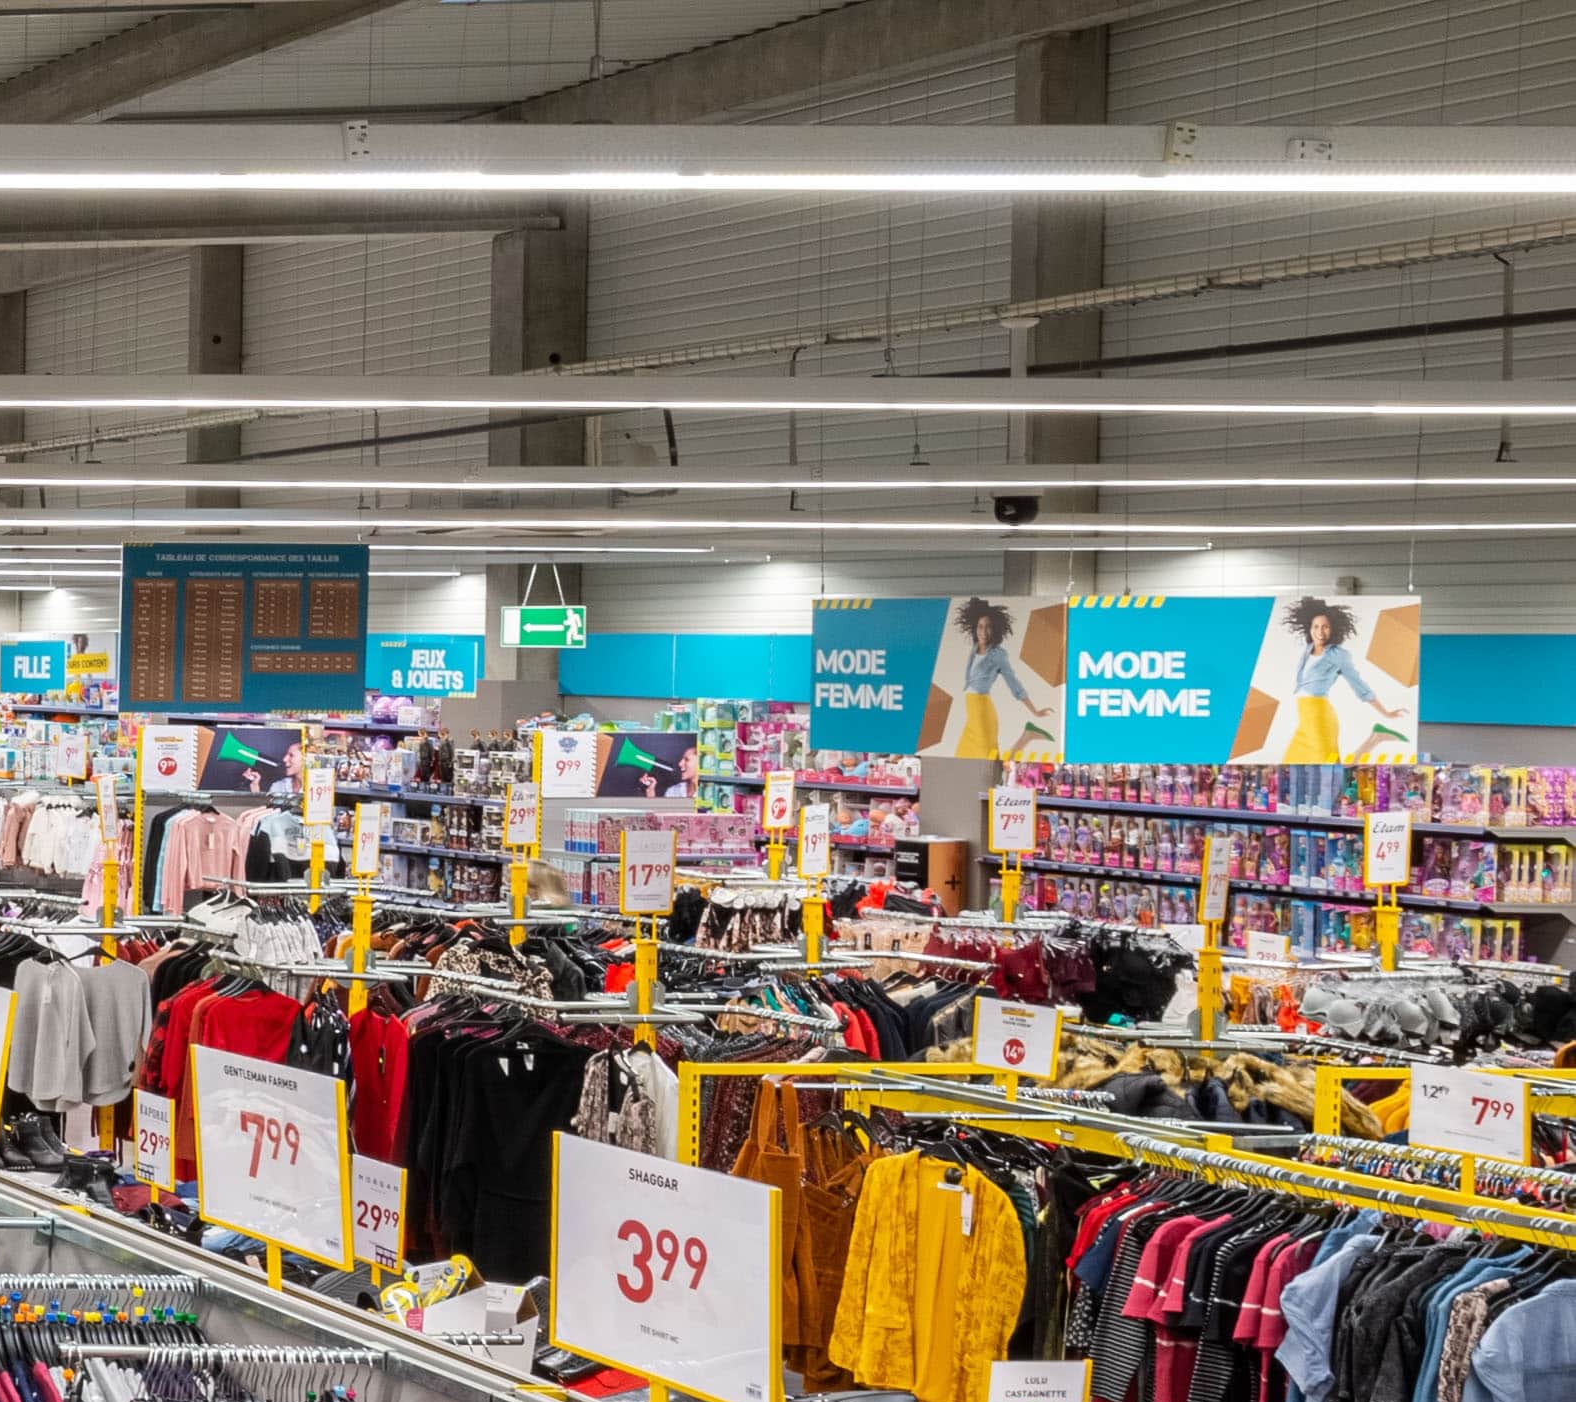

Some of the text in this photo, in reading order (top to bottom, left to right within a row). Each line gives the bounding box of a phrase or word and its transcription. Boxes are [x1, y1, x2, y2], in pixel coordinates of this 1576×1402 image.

[14, 654, 51, 680] FILLE
[410, 649, 446, 670] JEUX
[816, 649, 886, 676] MODE
[1078, 651, 1186, 679] MODE
[407, 669, 464, 690] JOUETS
[815, 683, 903, 711] FEMME
[1078, 689, 1210, 718] FEMME
[223, 1064, 299, 1092] GENTLEMAN FARMER
[628, 1166, 679, 1192] SHAGGAR
[1025, 1376, 1048, 1385] LULU
[1005, 1389, 1067, 1399] CASTAGNETTE
